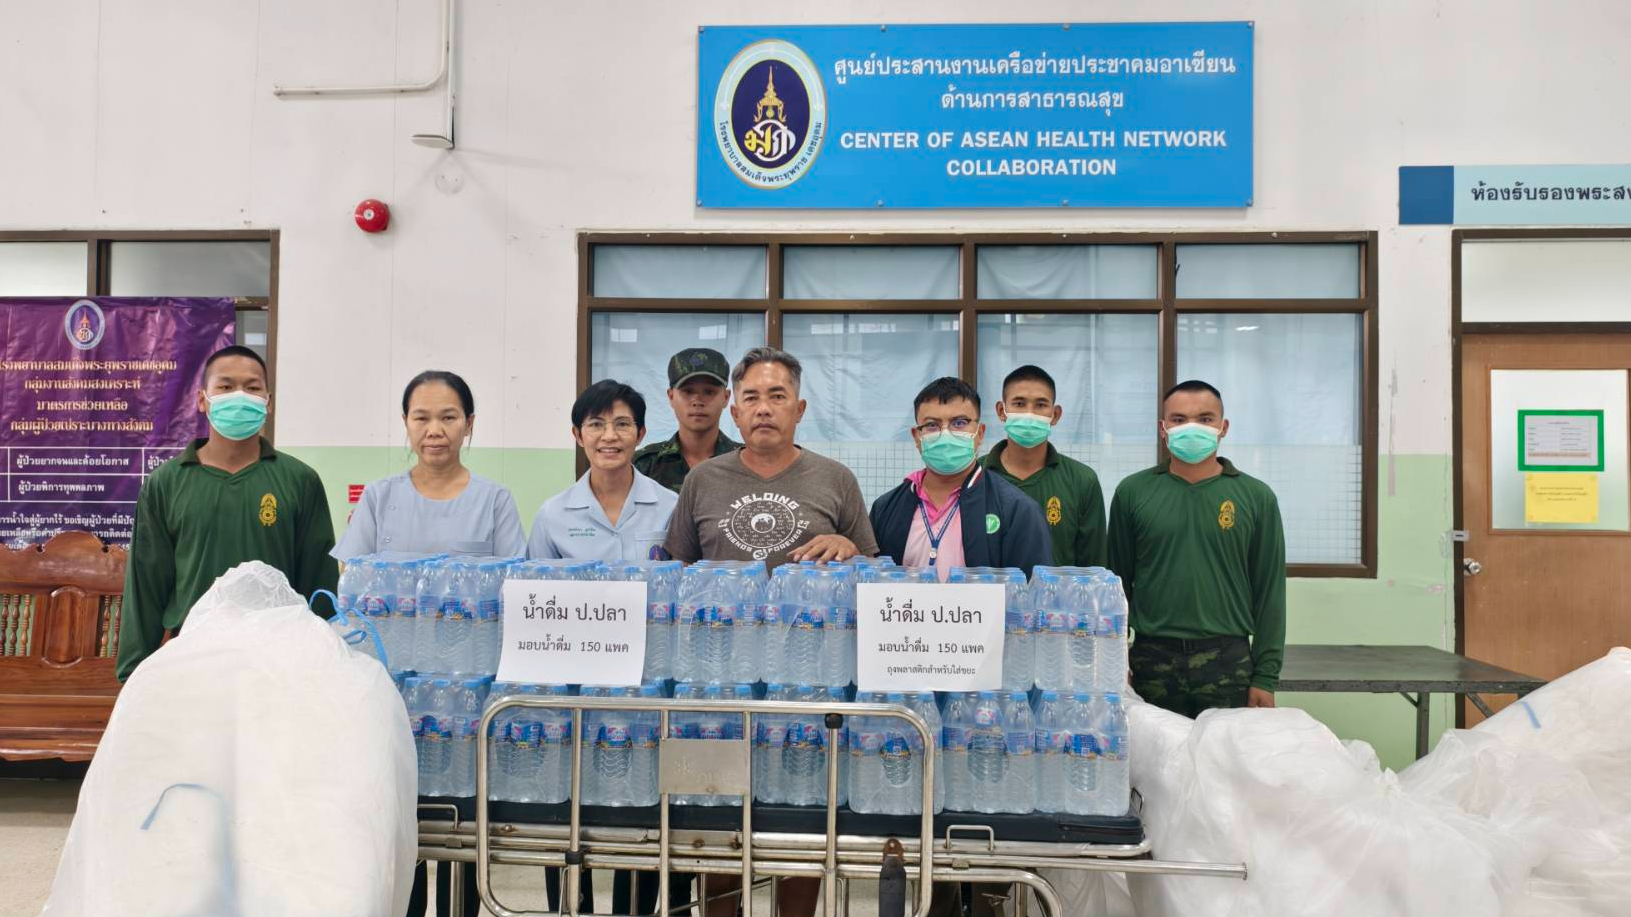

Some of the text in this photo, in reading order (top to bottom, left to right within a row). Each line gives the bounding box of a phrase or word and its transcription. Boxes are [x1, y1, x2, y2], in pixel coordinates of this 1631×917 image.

[941, 83, 1124, 117] ด้านการสาธารณสุข
[840, 130, 1227, 148] CENTER OF ASEAN HEALTH NETWORK
[946, 158, 1116, 176] COLLABORATION
[523, 593, 568, 620] น้ำดื่ม
[575, 603, 627, 621] ป.ปลา
[880, 597, 924, 623] น้ำดื่ม
[931, 606, 982, 623] ป.ปลา
[518, 633, 629, 653] มอบน้ำดื่ม 150 แพค
[878, 636, 985, 654] มอบน้ำดื่ม 150 แพค
